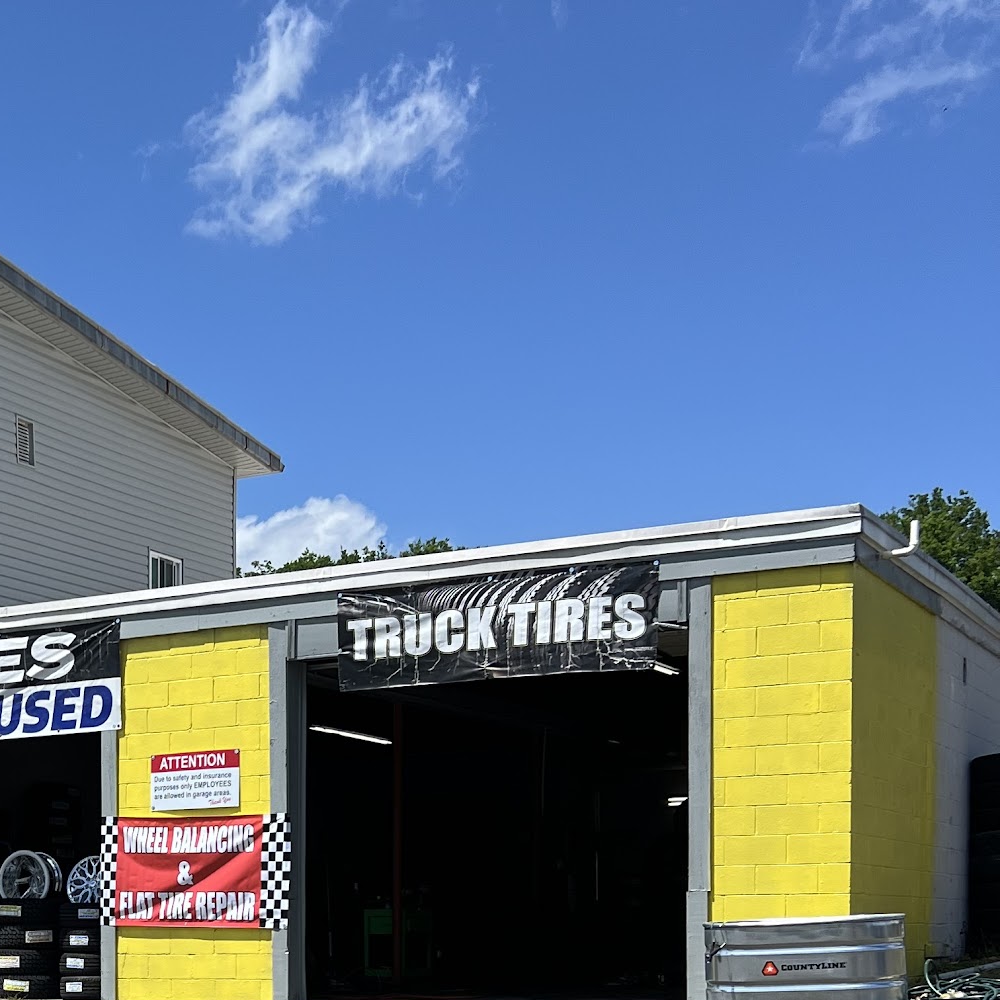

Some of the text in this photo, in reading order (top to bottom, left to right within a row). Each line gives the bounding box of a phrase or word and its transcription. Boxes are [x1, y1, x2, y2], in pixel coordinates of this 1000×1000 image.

[347, 592, 648, 662] TRUCK TIRES
[159, 753, 225, 770] ATTENTION
[154, 784, 179, 792] purposes
[194, 780, 231, 788] EMPLOYEES
[193, 791, 212, 799] garage
[123, 824, 255, 854] WHEEL BALANCING
[177, 861, 194, 886] &
[119, 891, 255, 921] FLAT TIRE REPAIR
